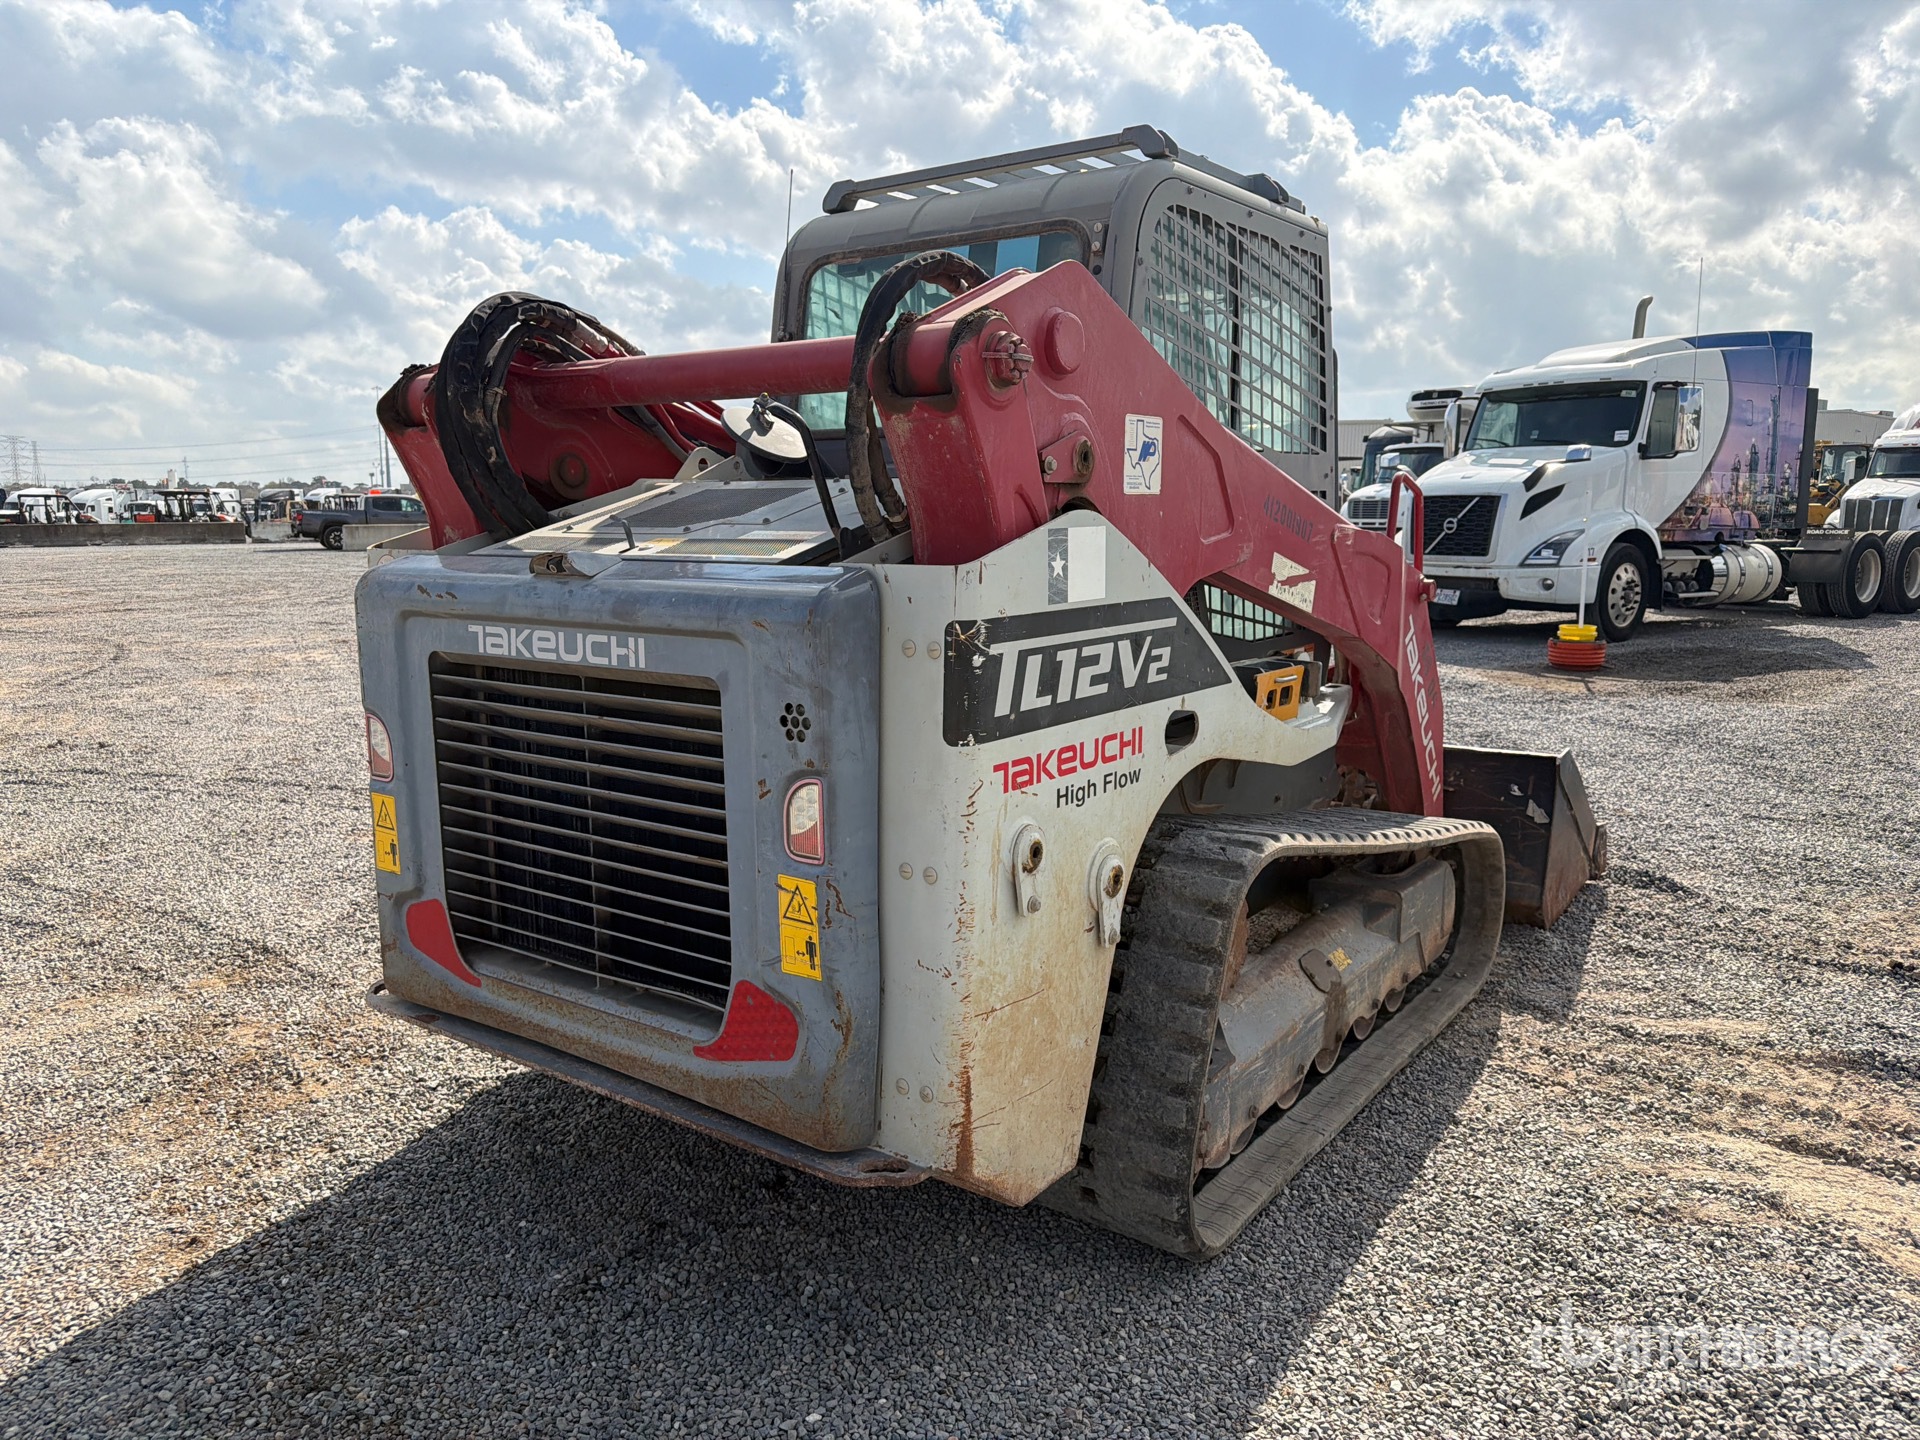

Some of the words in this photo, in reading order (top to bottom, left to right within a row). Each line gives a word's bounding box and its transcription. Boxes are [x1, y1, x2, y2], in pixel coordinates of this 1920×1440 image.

[467, 624, 646, 669] TAKEUCHI
[989, 616, 1178, 718] TL12V2
[1404, 613, 1442, 803] TAKEUCHI
[992, 726, 1143, 794] TAKEUCHI
[1056, 779, 1097, 809] High
[1103, 768, 1142, 793] Flow
